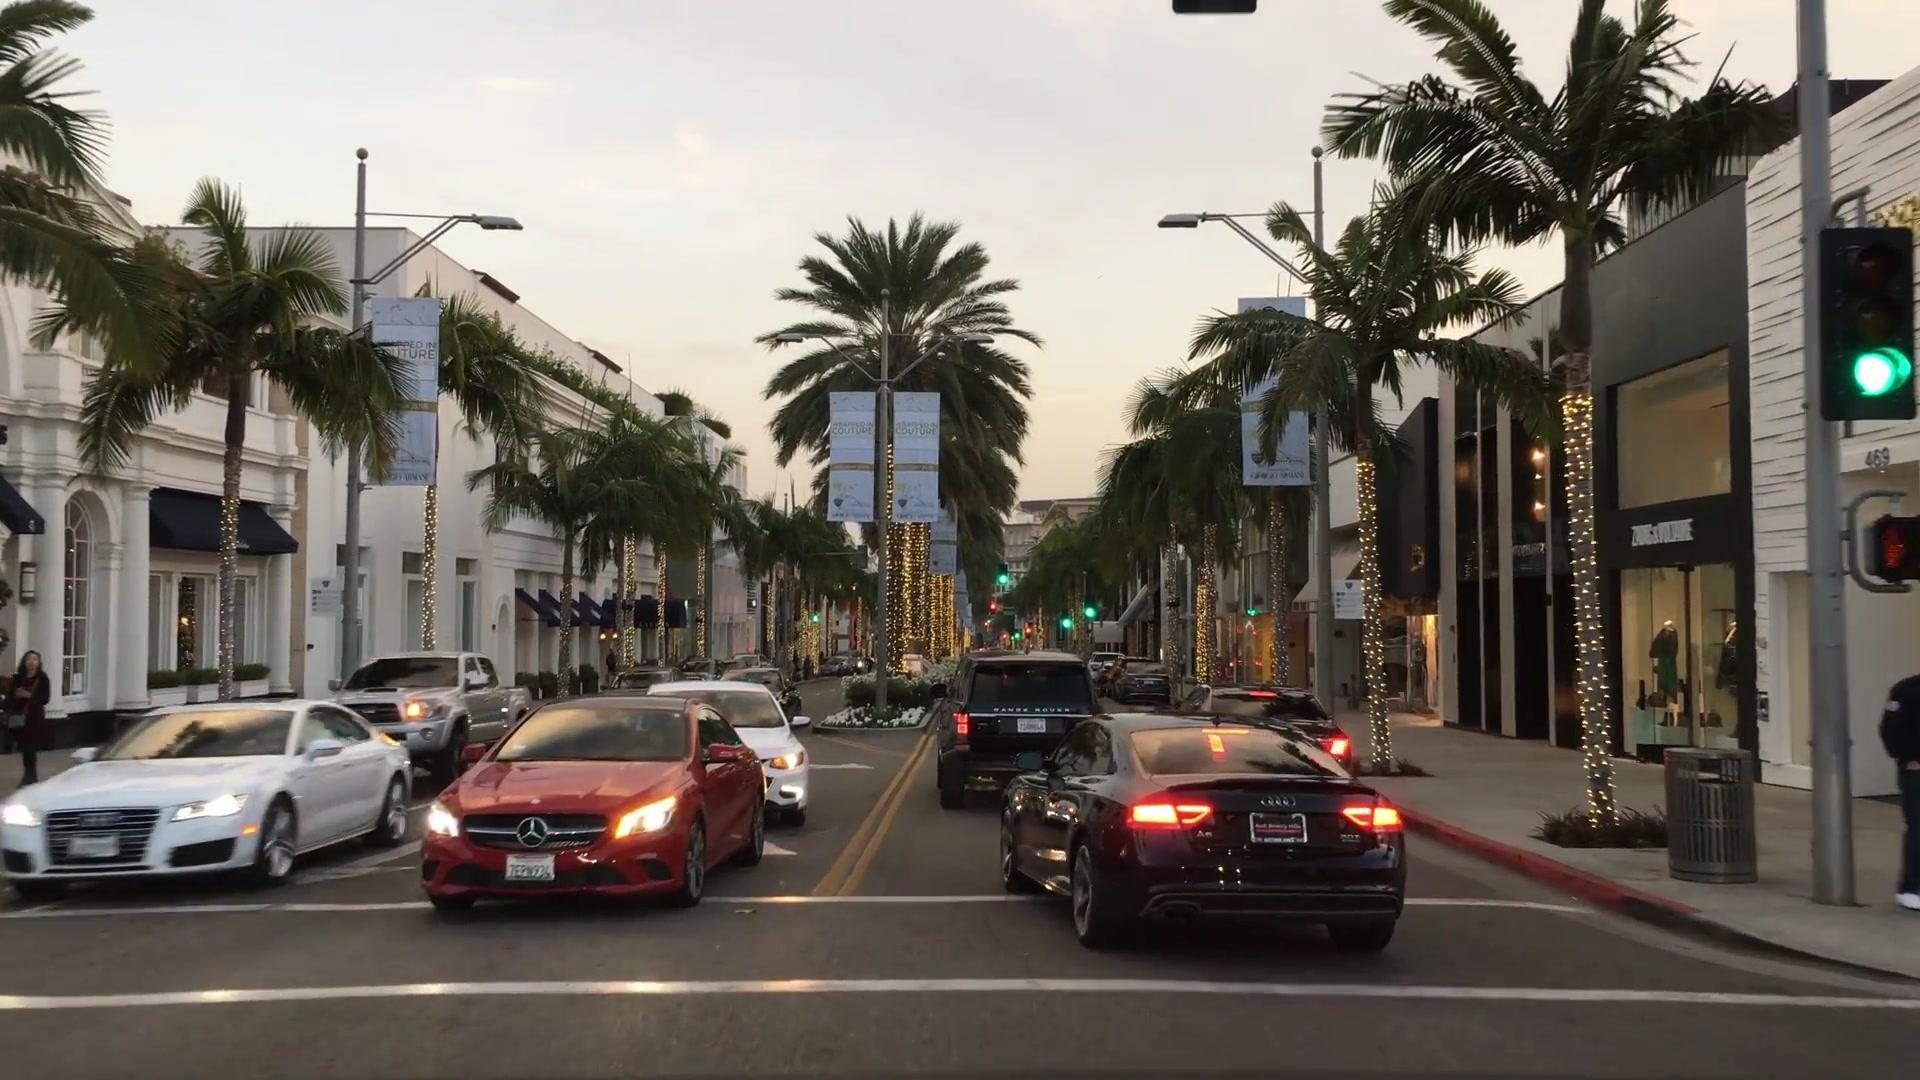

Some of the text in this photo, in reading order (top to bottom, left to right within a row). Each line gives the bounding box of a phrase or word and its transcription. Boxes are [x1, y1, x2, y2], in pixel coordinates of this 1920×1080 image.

[832, 427, 873, 435] COUTURE
[895, 428, 936, 436] COUTURE
[1865, 447, 1890, 467] 469
